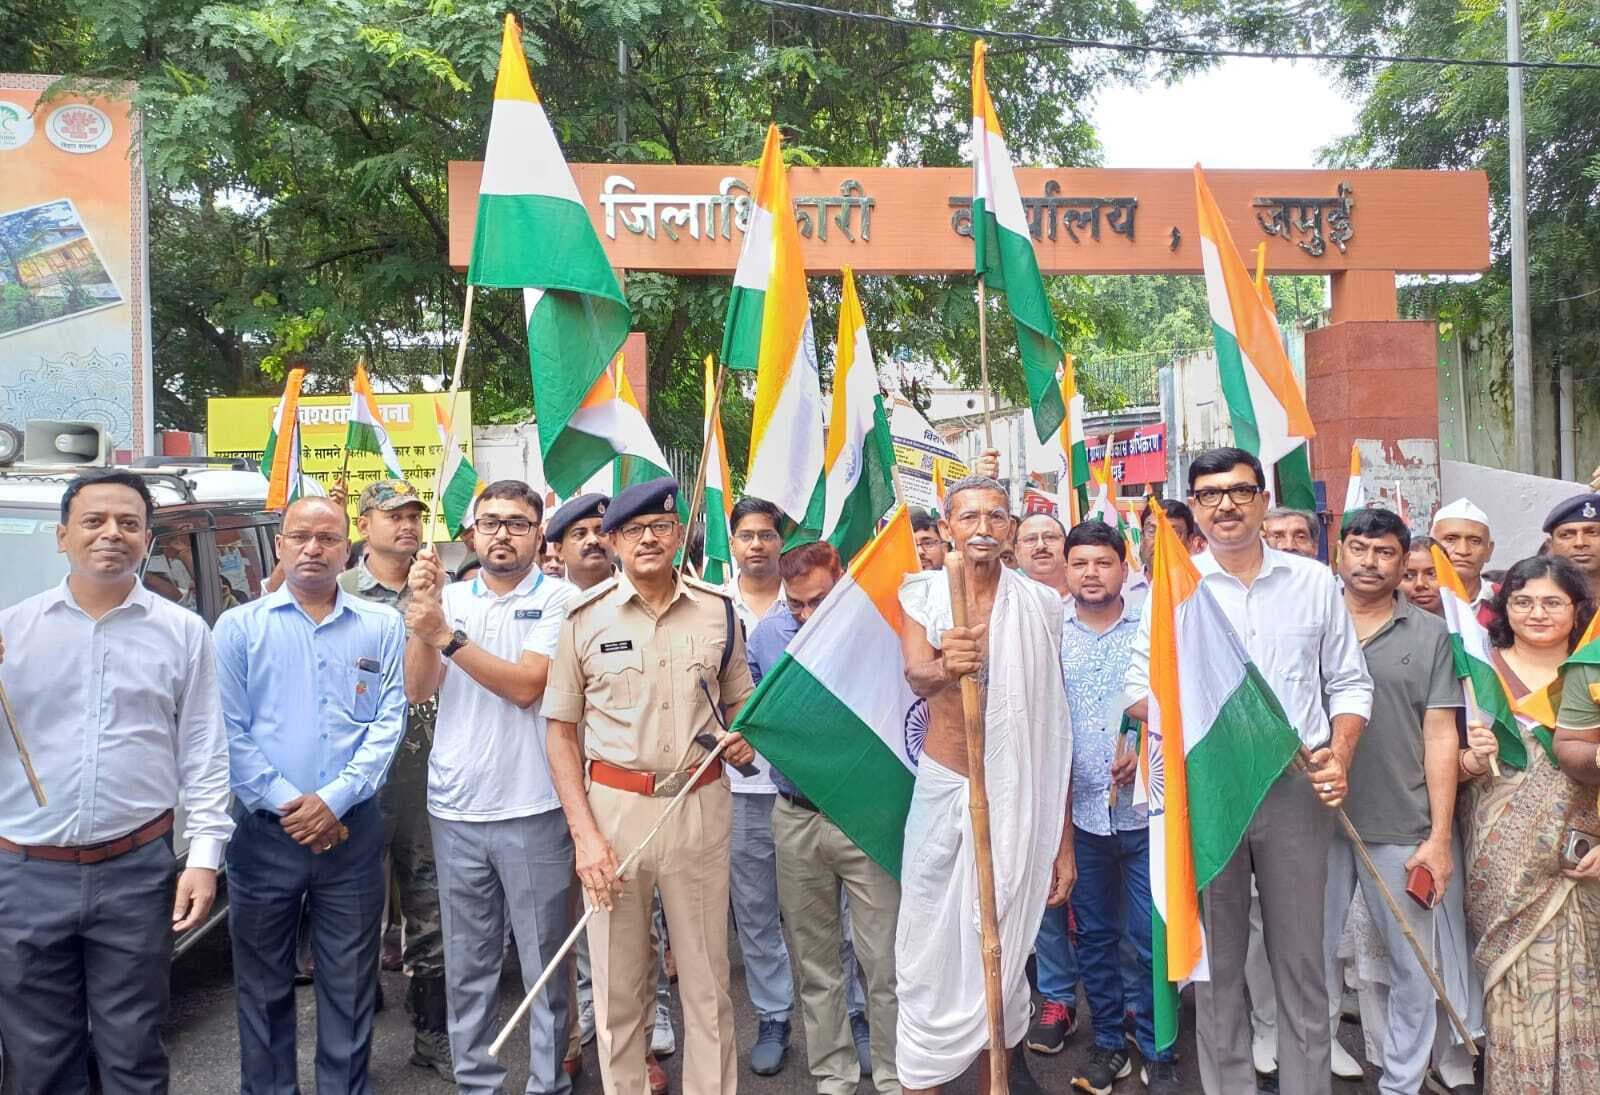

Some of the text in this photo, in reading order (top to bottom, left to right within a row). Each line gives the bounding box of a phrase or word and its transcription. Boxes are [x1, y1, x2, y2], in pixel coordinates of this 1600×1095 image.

[949, 180, 1138, 243] र्यालय
[1252, 180, 1354, 256] जमुई
[314, 444, 341, 459] सामने
